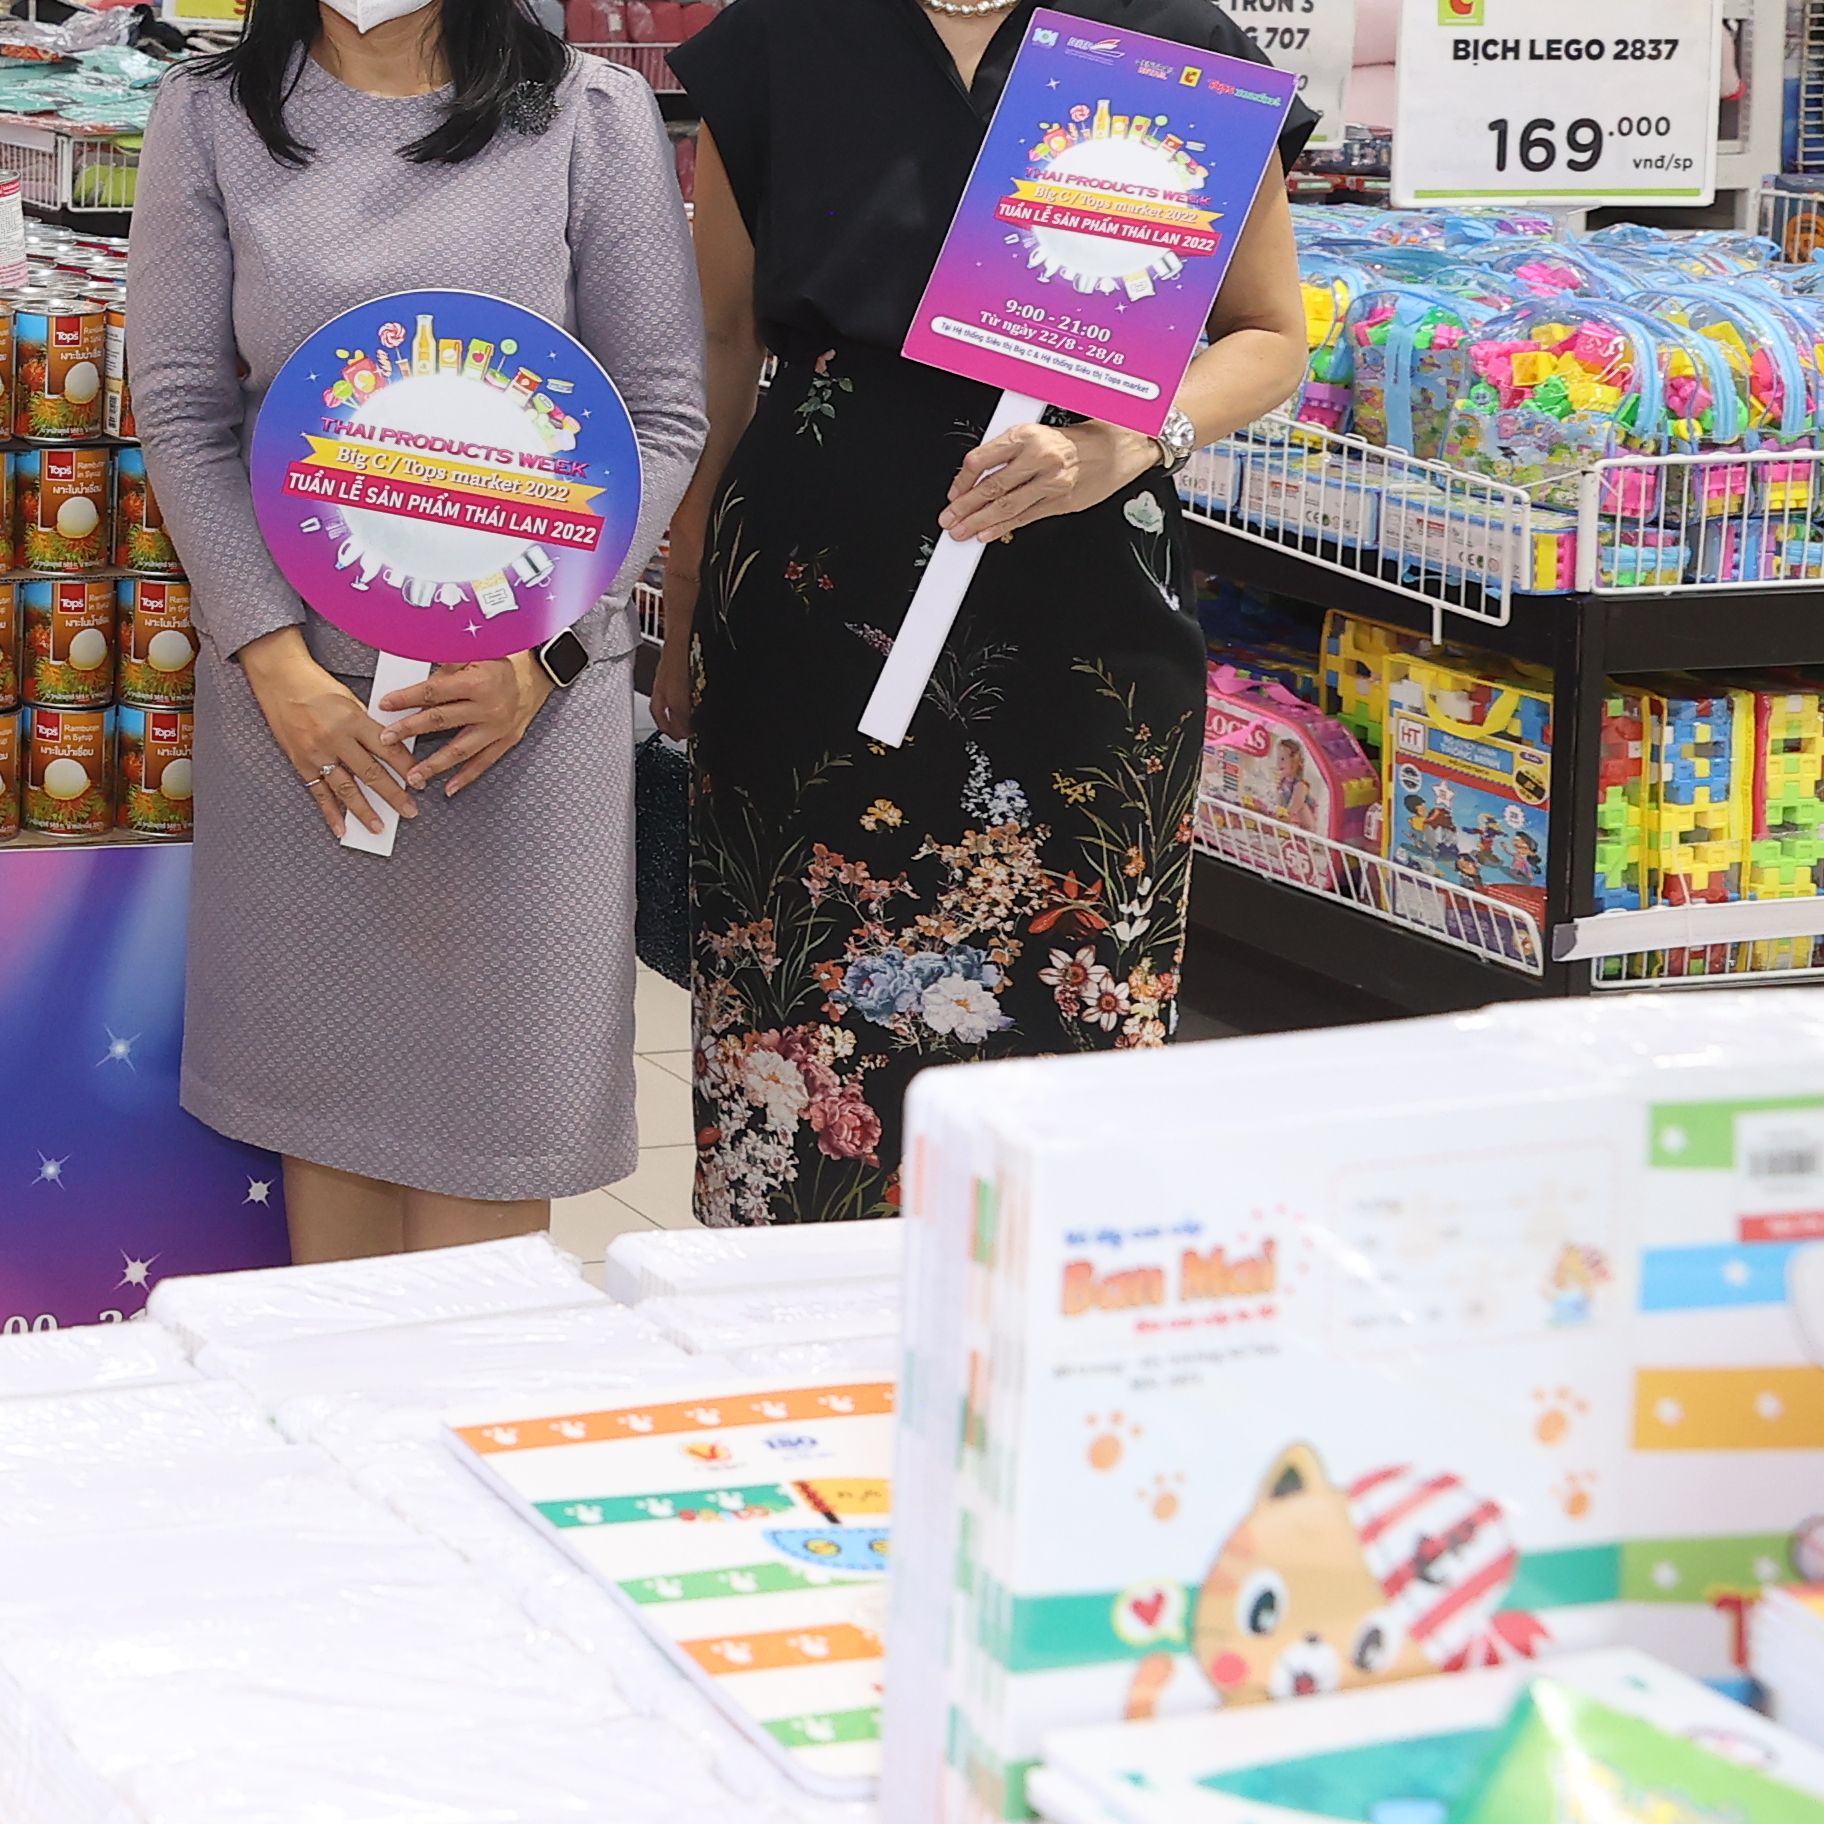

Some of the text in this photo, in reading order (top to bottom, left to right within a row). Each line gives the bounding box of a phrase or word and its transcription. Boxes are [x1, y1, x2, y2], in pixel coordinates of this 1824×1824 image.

[1265, 28, 1310, 49] 707
[1452, 39, 1680, 66] BỊCH LEGO 2837
[1488, 117, 1671, 172] 169 .000
